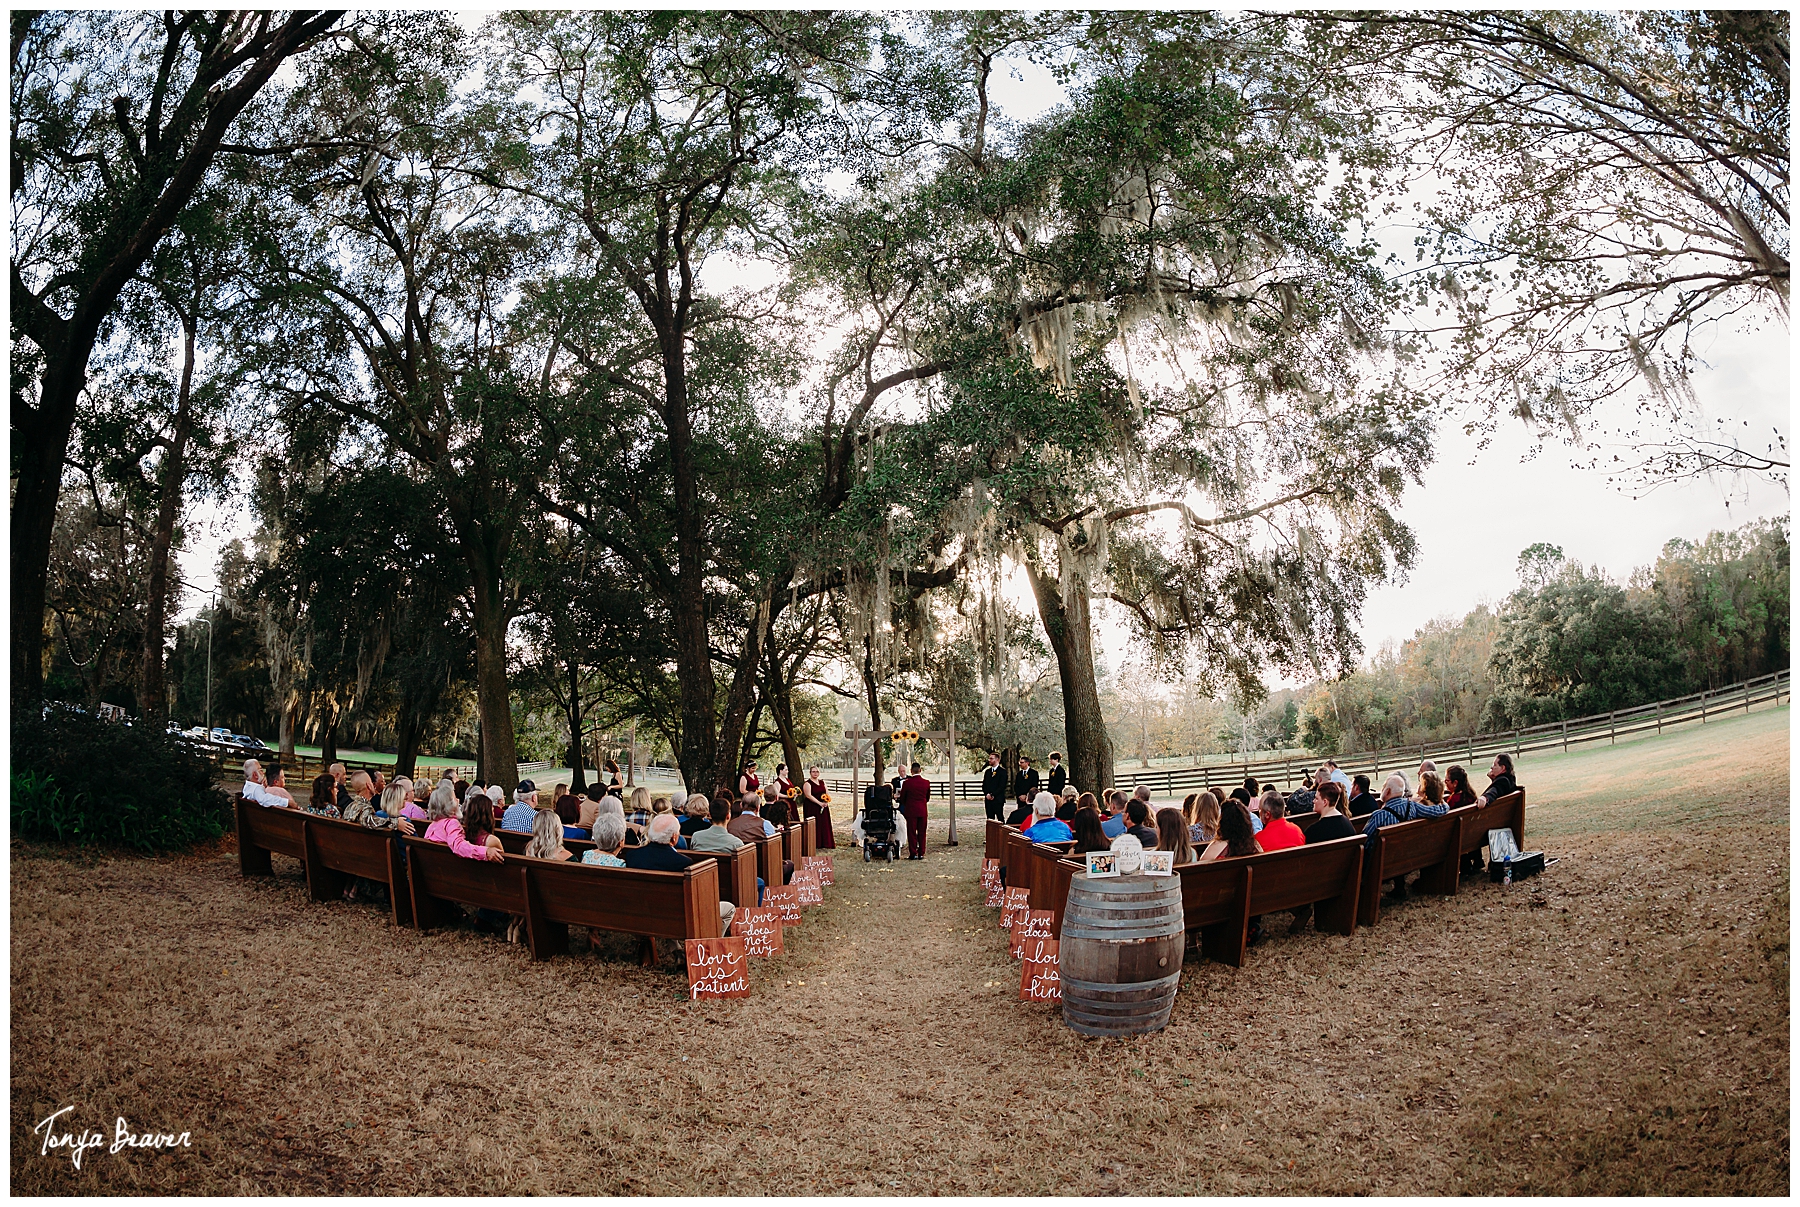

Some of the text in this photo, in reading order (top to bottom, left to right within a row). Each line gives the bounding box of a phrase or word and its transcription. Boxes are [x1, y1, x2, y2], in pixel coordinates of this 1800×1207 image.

[804, 856, 828, 868] love
[982, 860, 1000, 872] lo
[762, 888, 794, 902] love
[735, 907, 778, 925] love
[1015, 910, 1051, 927] love
[741, 923, 776, 936] does
[1017, 925, 1053, 939] does
[743, 934, 773, 946] not
[690, 943, 743, 967] love
[1025, 940, 1060, 965] lov
[700, 965, 738, 980] is
[1033, 967, 1061, 981] is
[690, 976, 750, 1000] patient
